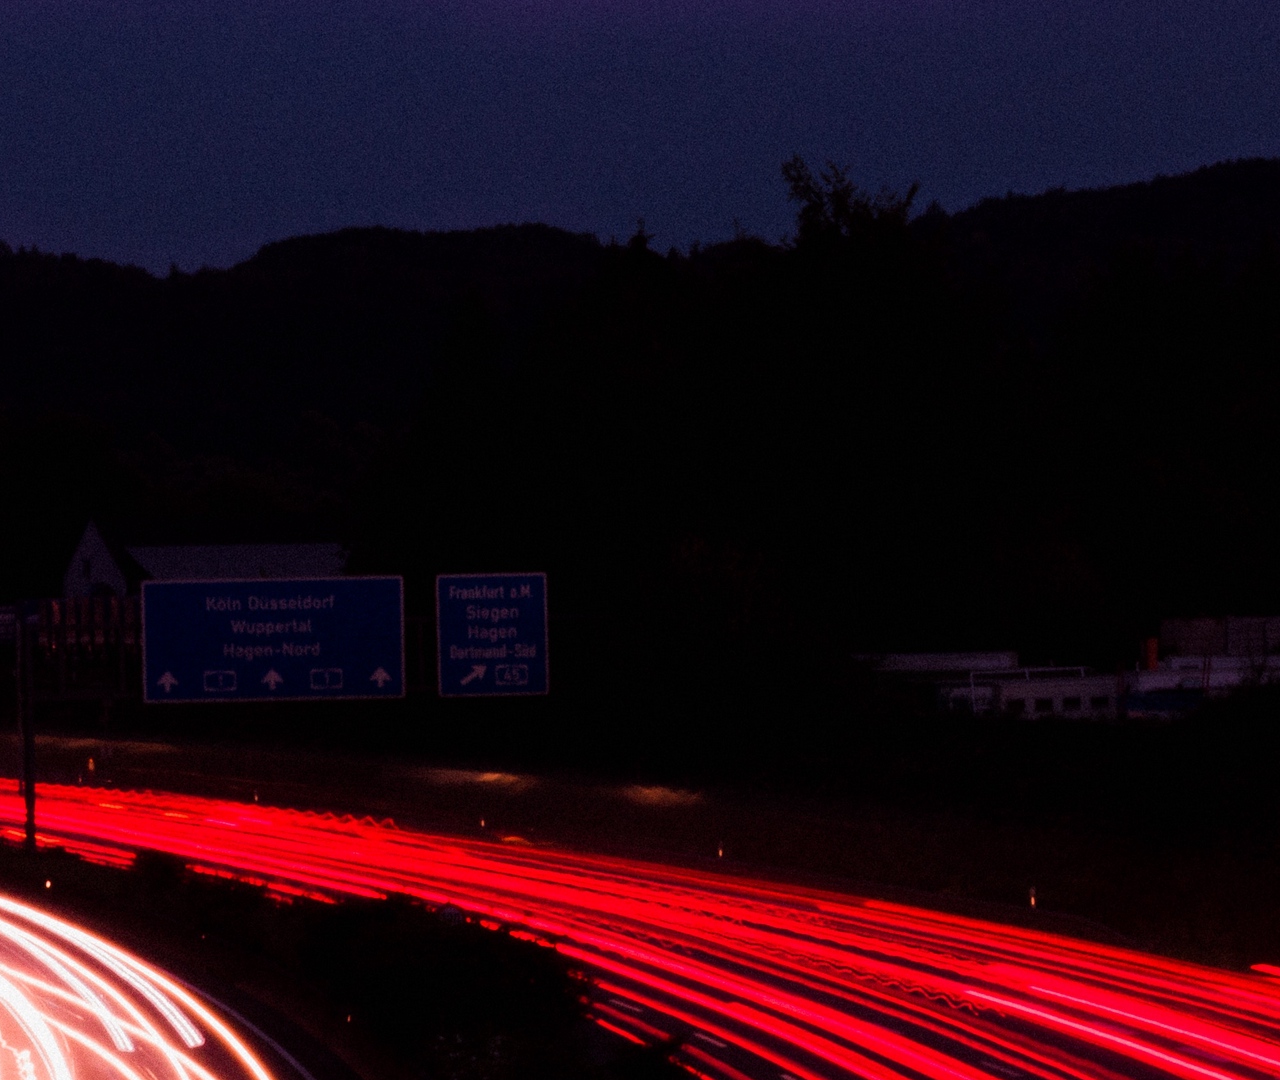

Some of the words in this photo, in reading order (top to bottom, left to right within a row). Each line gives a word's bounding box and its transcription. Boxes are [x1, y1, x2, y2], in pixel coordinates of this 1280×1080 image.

[247, 594, 336, 610] Düsseldorf
[466, 604, 519, 623] Siegen
[230, 618, 312, 637] Wuppertal
[467, 626, 518, 643] Hagen
[222, 641, 321, 661] Hagen-Nord
